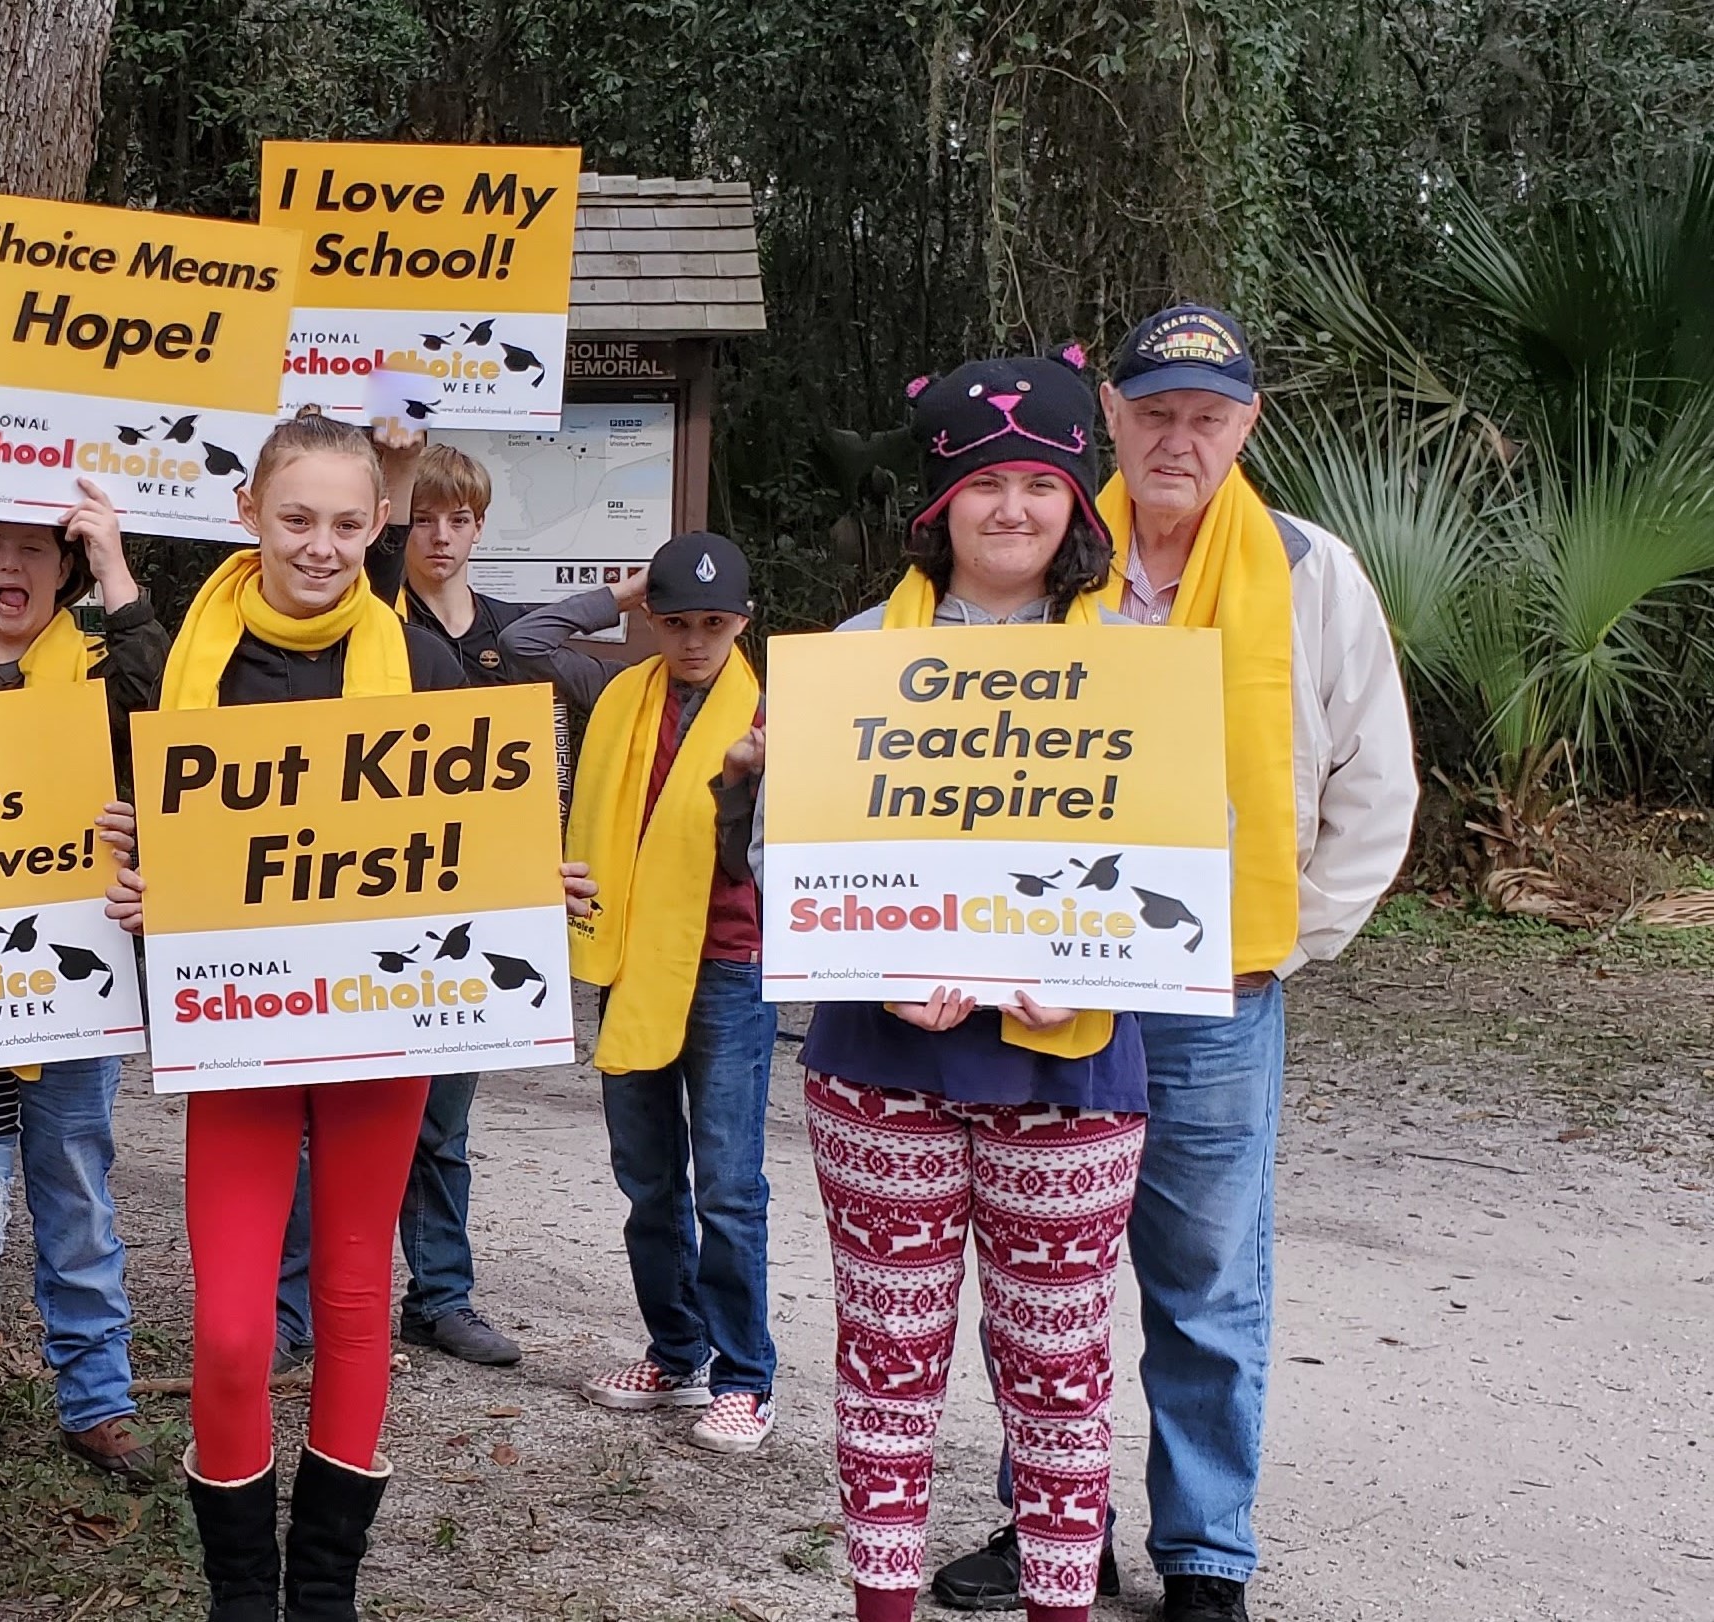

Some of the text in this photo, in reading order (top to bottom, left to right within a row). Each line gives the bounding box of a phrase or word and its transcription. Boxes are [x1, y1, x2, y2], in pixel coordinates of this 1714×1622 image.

[279, 168, 558, 229] I Love My
[127, 243, 278, 292] Means
[310, 231, 515, 280] School!
[13, 291, 222, 369] Hope!
[290, 332, 360, 344] ATIONAL
[1138, 315, 1187, 350] VIETNAM
[567, 343, 638, 358] ROLINE
[1162, 348, 1223, 363] VETERAN
[443, 382, 496, 394] WEEK
[138, 482, 195, 498] WEEK
[898, 657, 1088, 703] Great
[853, 711, 1133, 761] Teachers
[161, 717, 531, 814] Put Kids
[866, 770, 1118, 831] Inspire!
[244, 822, 462, 904] First!
[794, 873, 919, 890] NATIONAL
[1051, 942, 1132, 960] WEEK
[176, 960, 292, 980] NATIONAL
[810, 970, 1182, 991] #schoolchoice www.schoolchoiceweek.com
[413, 1009, 486, 1028] WEEK
[198, 1038, 531, 1072] #schoolchoice www.schoolchoiceweek.com
